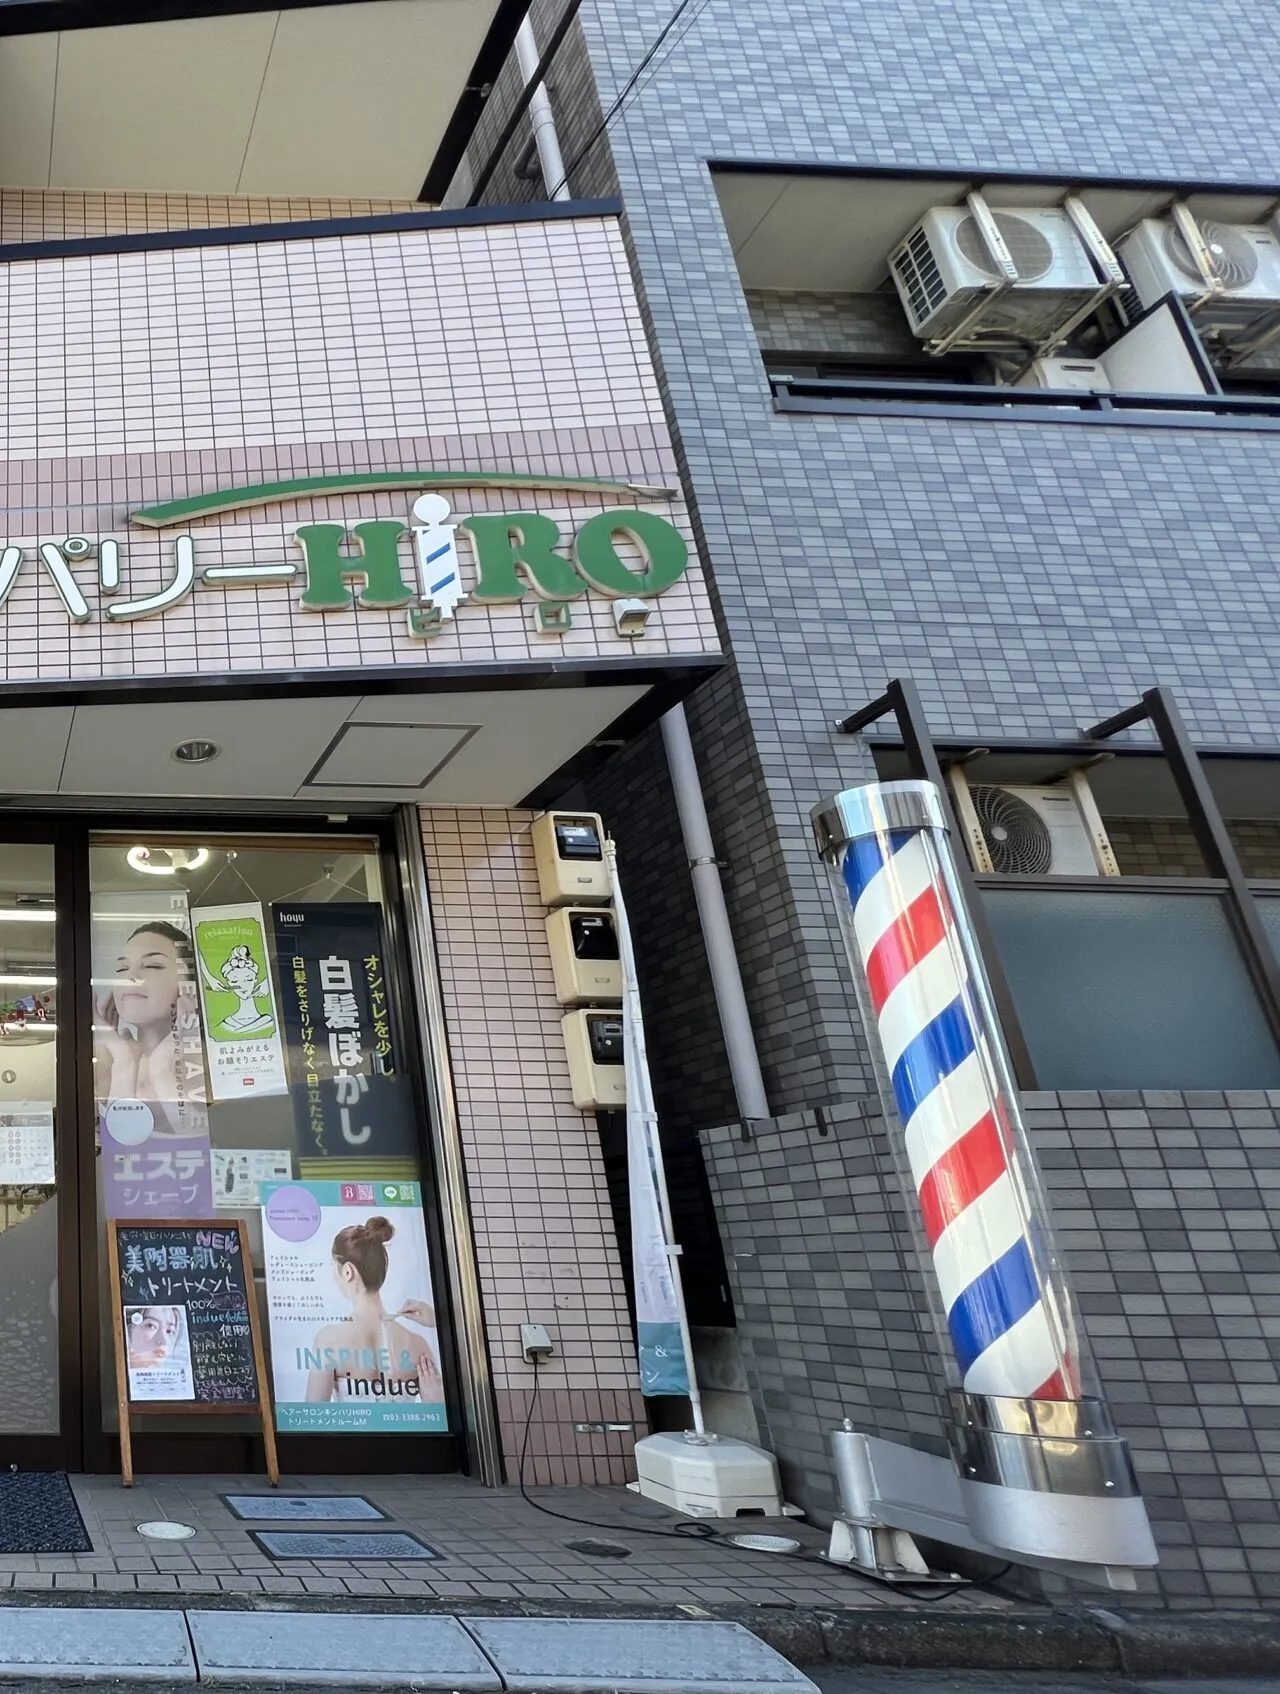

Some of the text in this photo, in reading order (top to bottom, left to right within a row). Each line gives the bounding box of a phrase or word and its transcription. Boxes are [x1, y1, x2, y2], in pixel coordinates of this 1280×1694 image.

[279, 911, 305, 924] hoyu
[217, 1054, 275, 1065] お顔そりエステ
[219, 1044, 270, 1055] 肌よみがえる
[319, 955, 371, 1145] 白髪ぼかし
[112, 1150, 205, 1182] エステ
[122, 1184, 201, 1207] シェーブ
[195, 1230, 240, 1254] NEW
[124, 1244, 219, 1274] 美陶器肌
[147, 1276, 238, 1297] トリートメント
[186, 1299, 216, 1311] 100%
[295, 1347, 391, 1371] INSPIRE
[346, 1371, 420, 1396] indue
